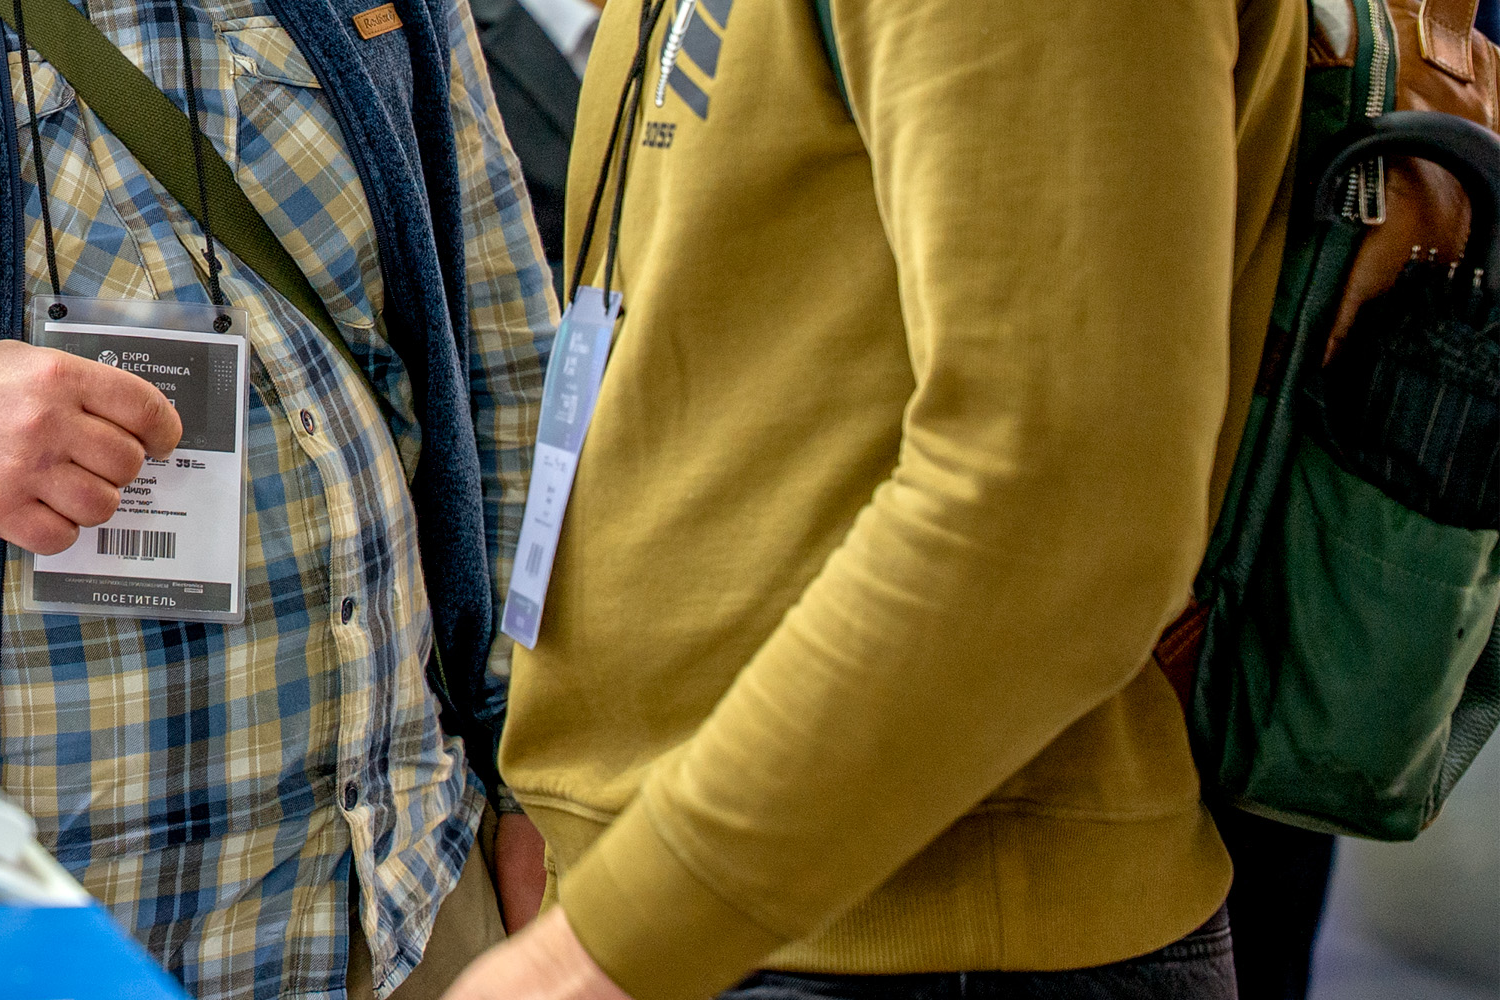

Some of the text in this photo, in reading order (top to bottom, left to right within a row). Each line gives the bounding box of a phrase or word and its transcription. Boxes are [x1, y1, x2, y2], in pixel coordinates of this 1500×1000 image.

[122, 352, 150, 362] EXPO
[122, 362, 191, 376] ELECTRONICA
[134, 477, 157, 485] трий
[92, 593, 177, 607] ПОСЕТИТЕЛЬ
